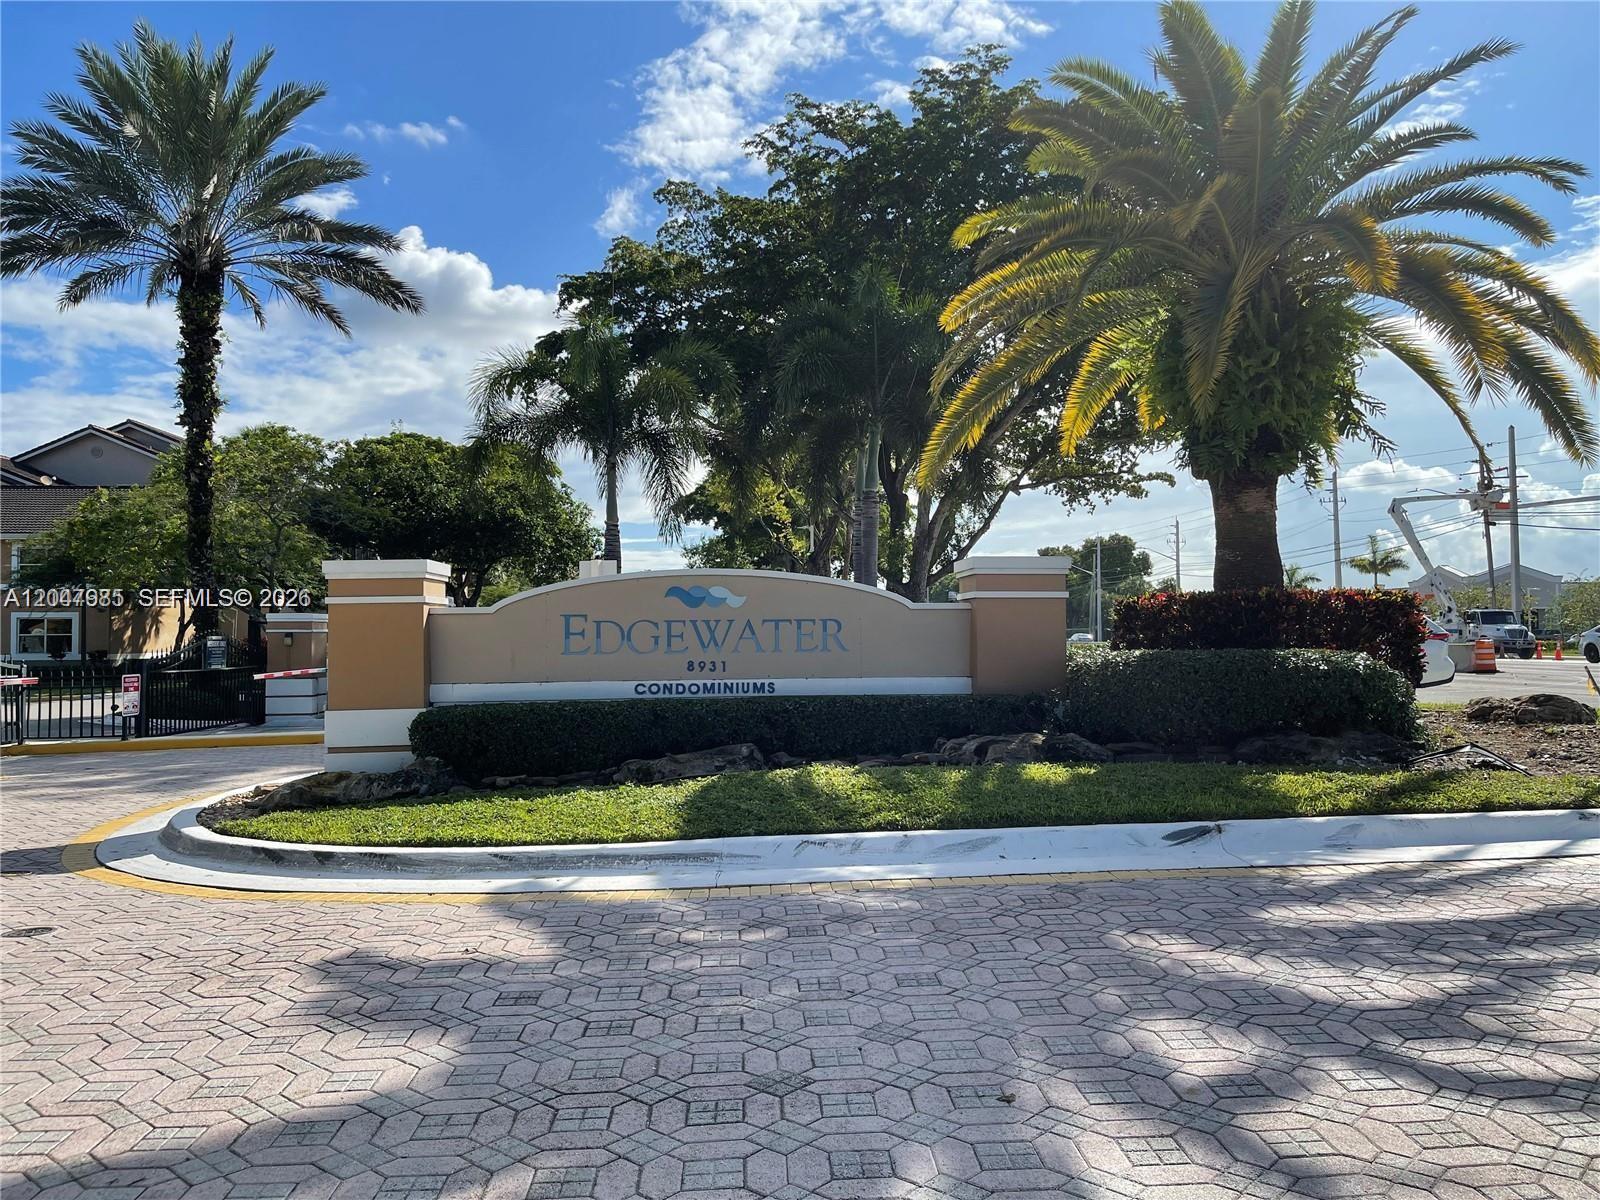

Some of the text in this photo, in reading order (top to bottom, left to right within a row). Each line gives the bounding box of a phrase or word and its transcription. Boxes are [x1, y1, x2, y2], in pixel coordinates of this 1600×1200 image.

[559, 613, 849, 656] EDGEWATER
[686, 660, 727, 673] 8931
[634, 682, 776, 695] CONDOMINIUMS
